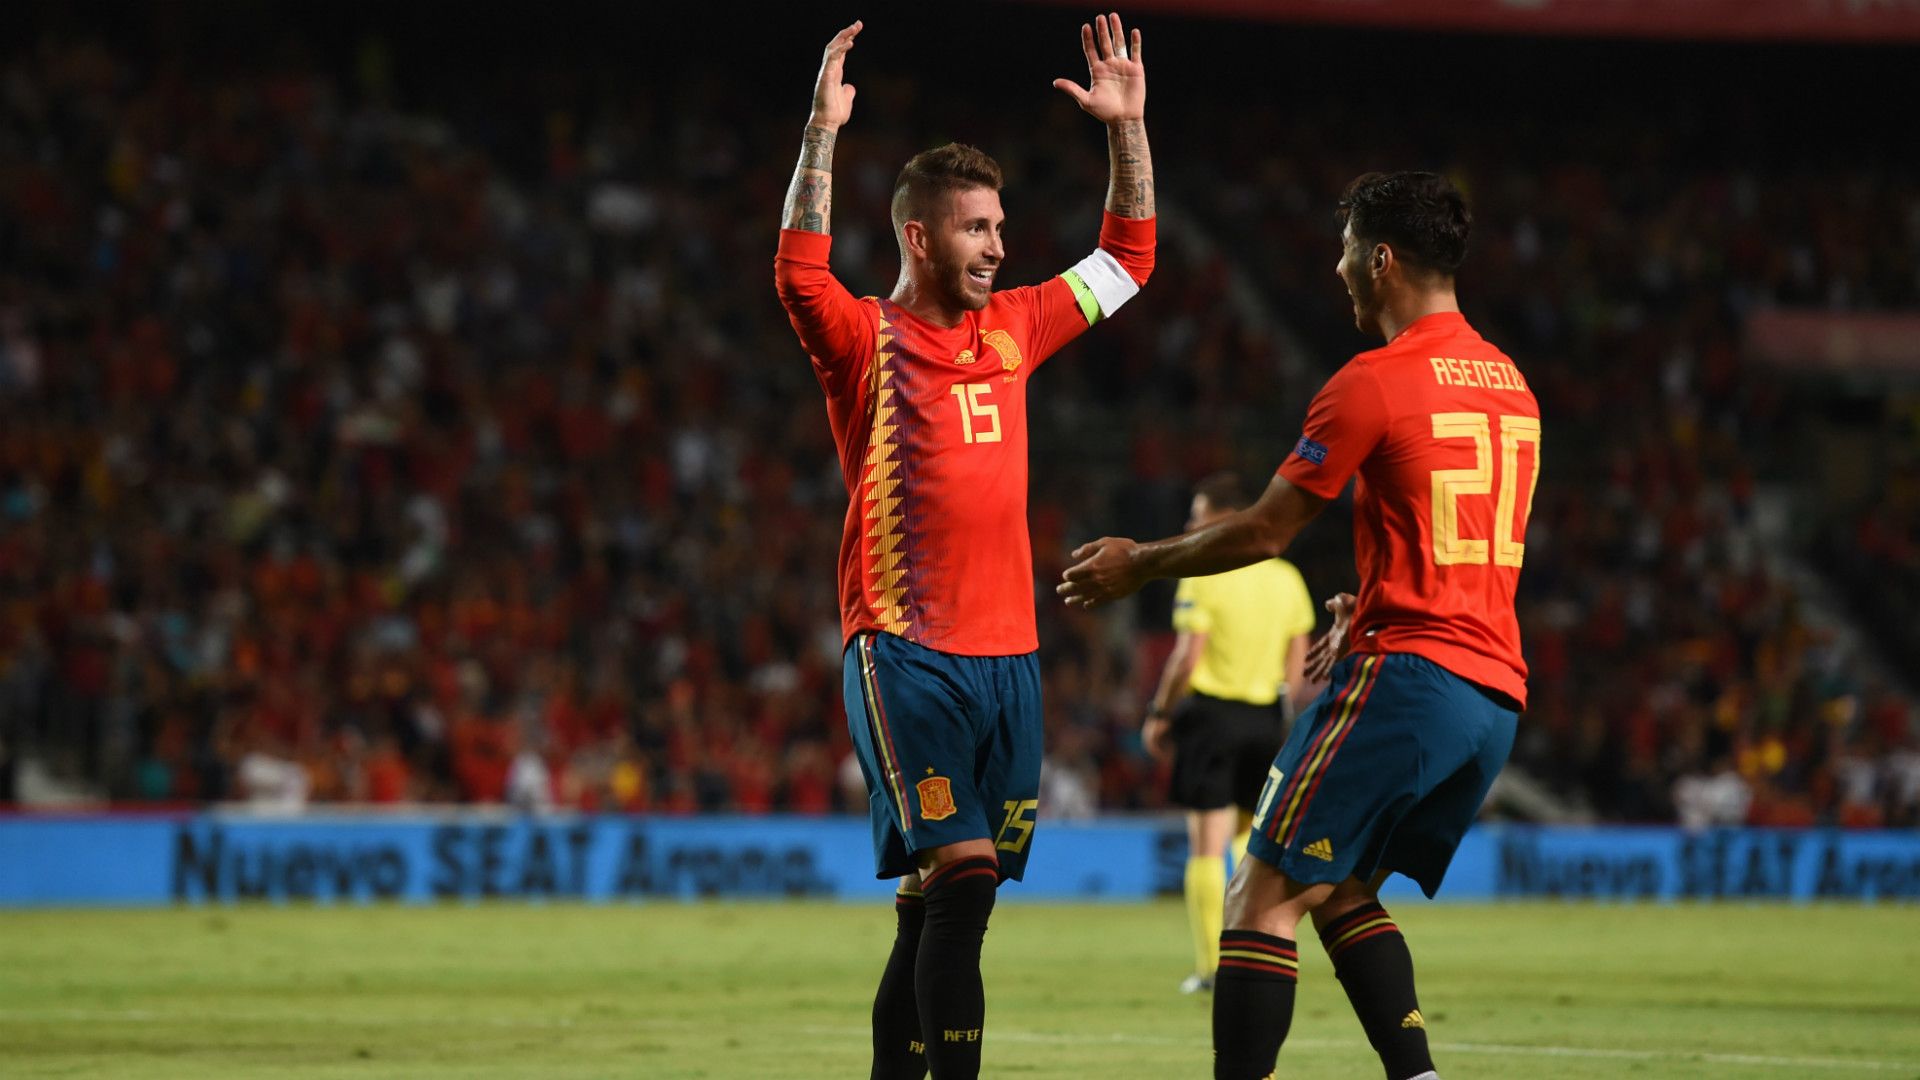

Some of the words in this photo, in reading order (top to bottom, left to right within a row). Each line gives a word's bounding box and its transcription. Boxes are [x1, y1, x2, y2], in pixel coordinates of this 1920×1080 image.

[1430, 358, 1526, 391] ASENSIO
[950, 383, 1002, 444] 15
[1430, 412, 1541, 568] 20
[994, 800, 1038, 853] 15
[174, 826, 407, 899] Nuevo
[430, 822, 597, 897] SEAT
[1497, 832, 1660, 900] Nuevo
[1674, 832, 1801, 900] SEAT
